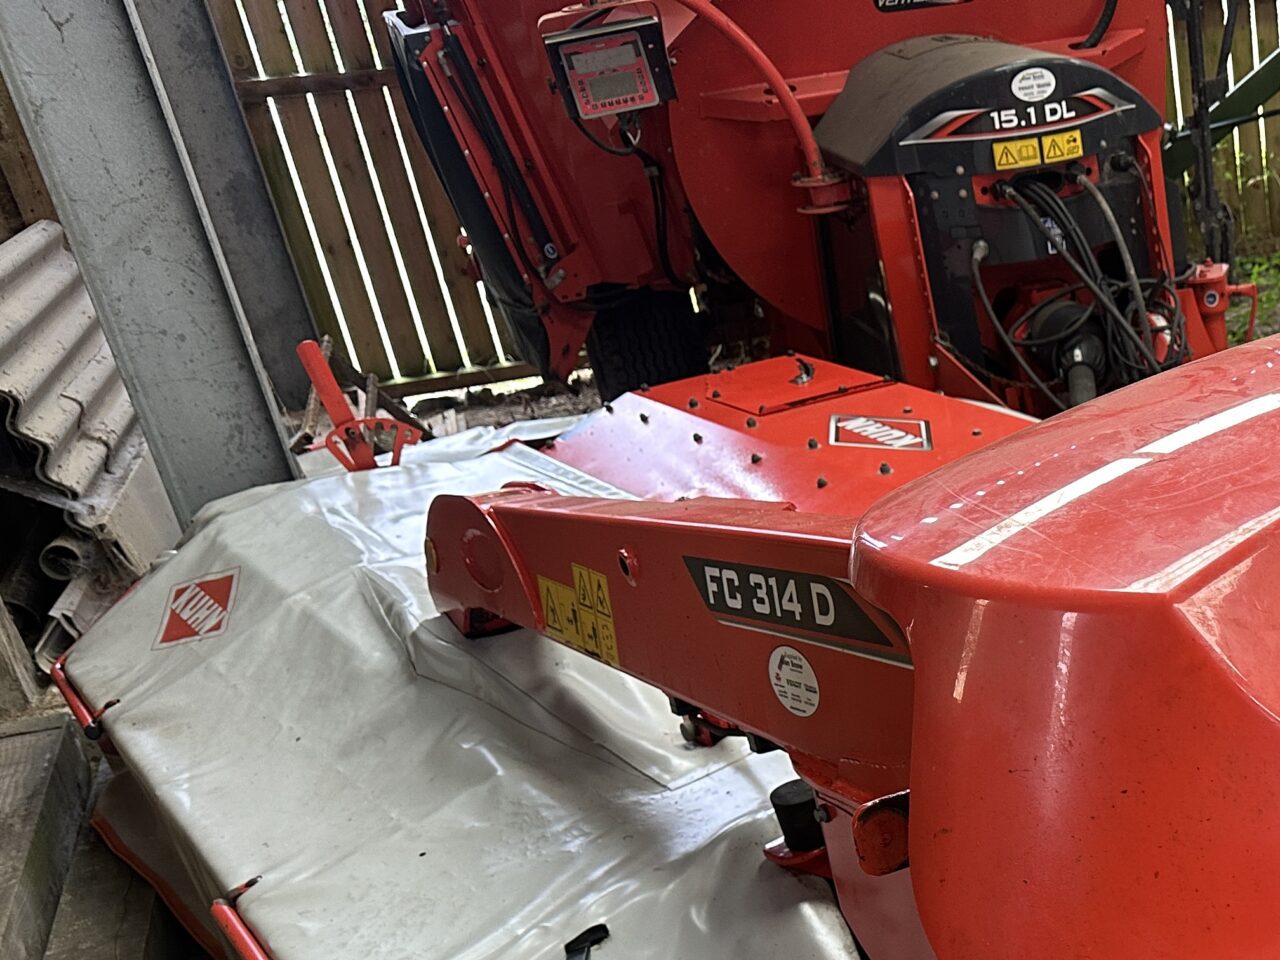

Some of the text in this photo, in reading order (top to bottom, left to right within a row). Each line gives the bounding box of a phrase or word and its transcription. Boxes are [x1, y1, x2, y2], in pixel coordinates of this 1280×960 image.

[990, 100, 1076, 130] 15.1 DL
[837, 416, 923, 448] KUHN
[171, 583, 228, 636] KUHN
[703, 565, 836, 626] FC 314 D
